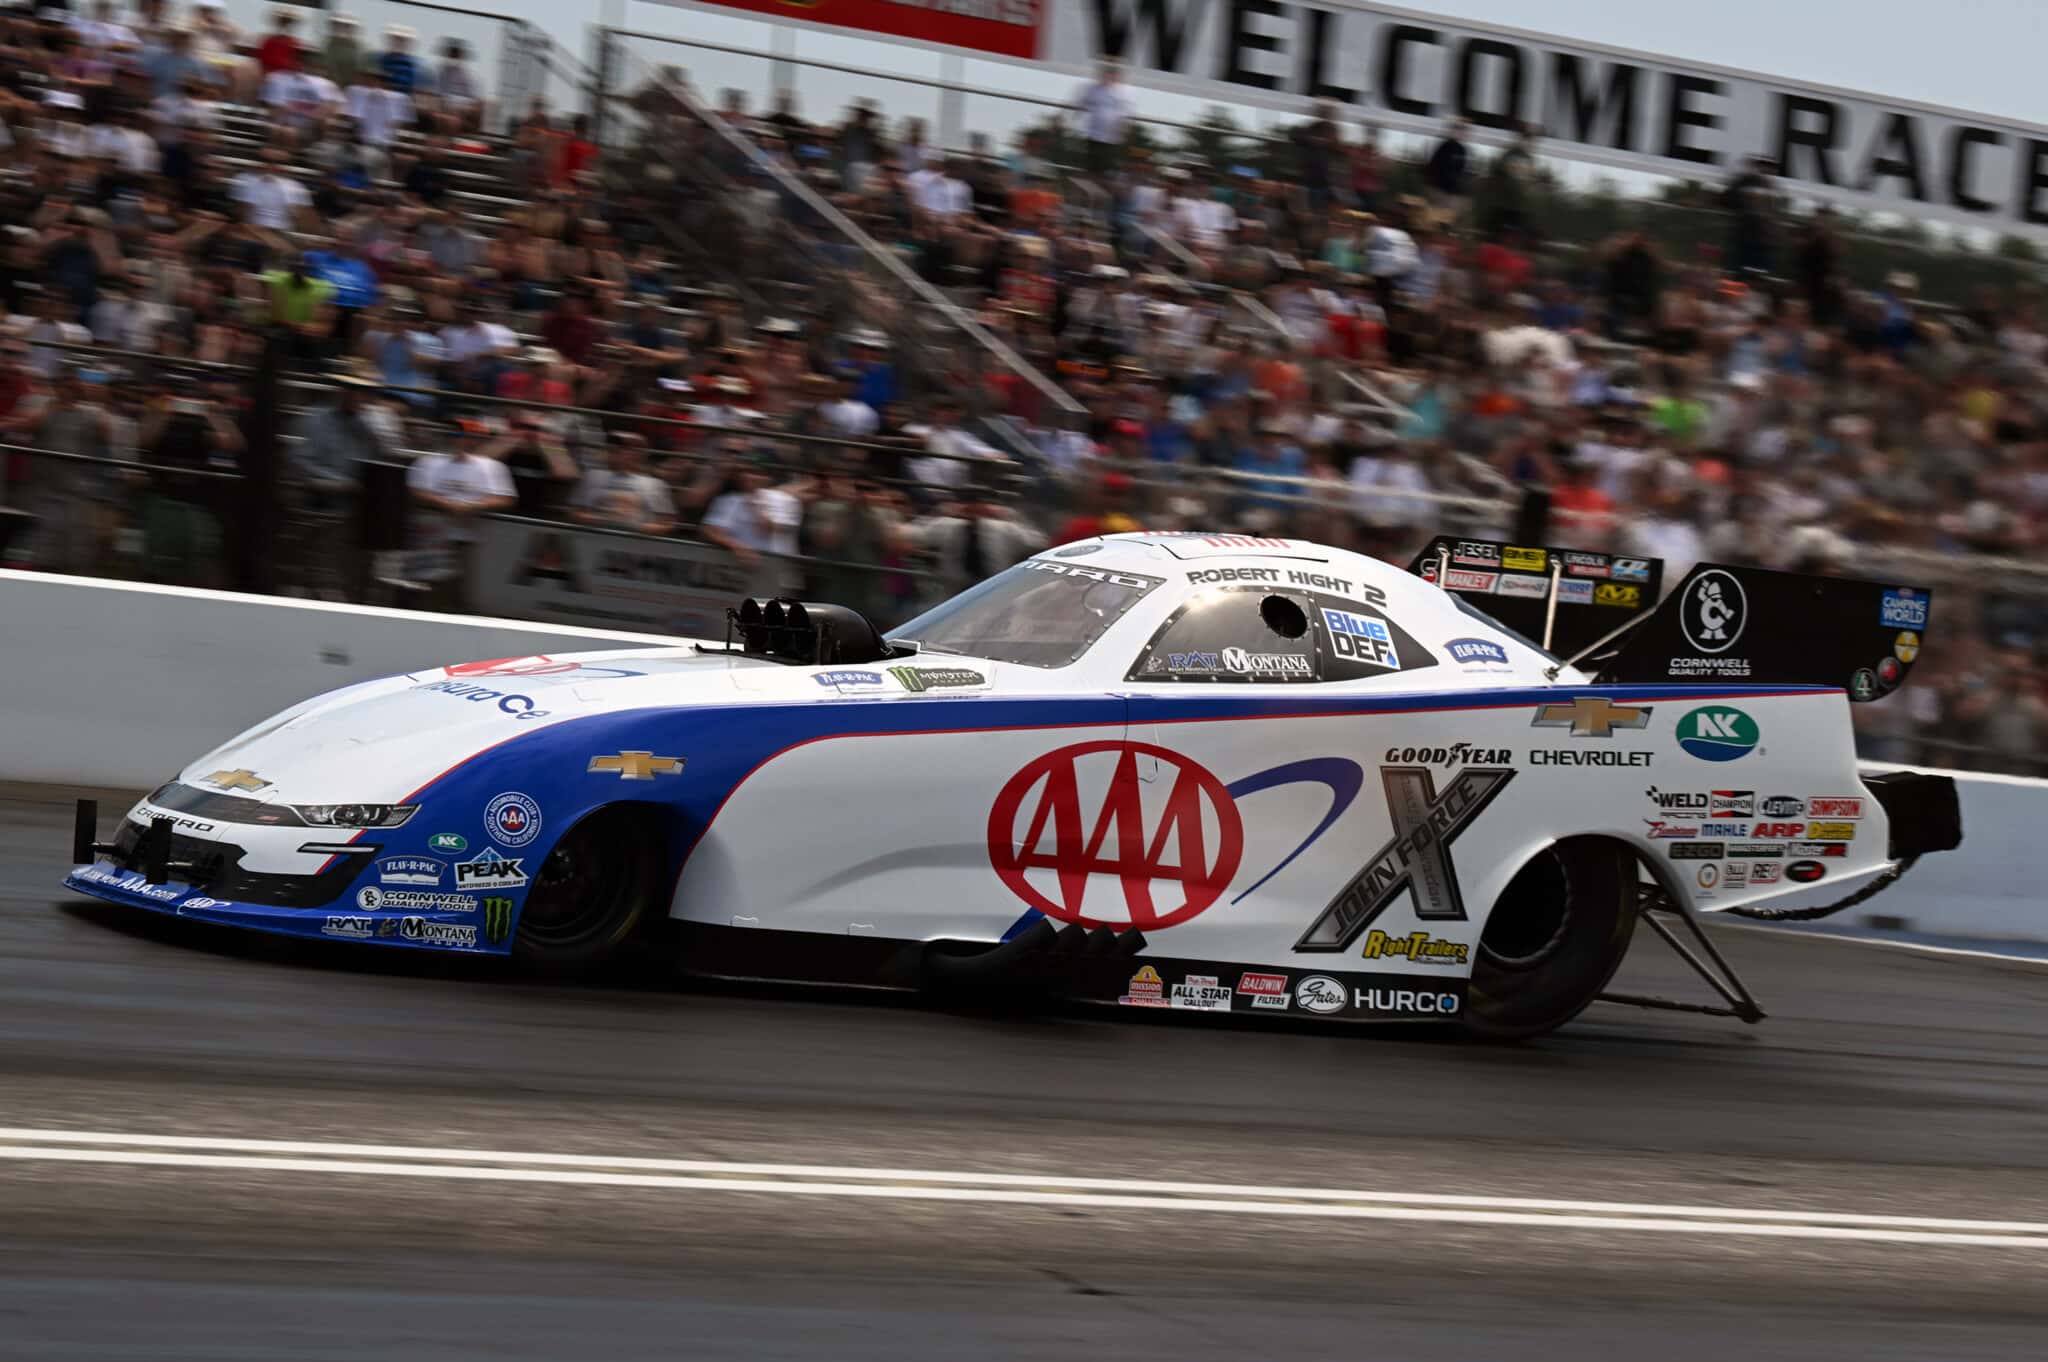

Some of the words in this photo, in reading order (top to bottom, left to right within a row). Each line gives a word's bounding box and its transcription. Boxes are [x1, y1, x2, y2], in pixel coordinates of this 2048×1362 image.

[1086, 0, 1726, 166] WELCOME
[1453, 542, 1500, 559] JESEL
[1186, 568, 1280, 584] ROBERT
[1288, 570, 1352, 594] HIGHT
[1363, 584, 1387, 608] 2
[1882, 596, 1927, 611] CAMPING
[1882, 607, 1925, 624] WORLD
[1324, 610, 1387, 641] Blue
[1331, 631, 1390, 662] DEF
[1222, 646, 1312, 674] MONTANA
[1670, 658, 1751, 668] CORNWELL
[919, 671, 978, 681] MONSTER
[1668, 668, 1714, 676] QUALITY
[1717, 668, 1752, 676] TOOLS
[1697, 713, 1741, 737] NK
[1530, 750, 1655, 767] CHEVROLET
[1659, 793, 1708, 808] WELD
[1711, 799, 1754, 809] CHAMPION
[1809, 799, 1860, 816] SIMPSON
[501, 811, 526, 825] AAA
[988, 740, 1244, 932] AAA
[1701, 824, 1748, 837] MAHLE
[1752, 823, 1805, 838] ARP
[437, 835, 458, 847] NK
[1333, 857, 1398, 938] JOHN
[1395, 776, 1478, 867] FORCE
[457, 860, 523, 883] PEAK
[383, 890, 475, 904] CORNWELL
[382, 900, 434, 910] QUALITY
[437, 902, 476, 912] TOOLS
[403, 917, 475, 940] MONTANA
[1242, 974, 1282, 993] BALDWIN
[1257, 995, 1286, 1006] FILTERS
[1300, 981, 1345, 1005] Gates
[1355, 988, 1459, 1014] HURCO
[1183, 998, 1217, 1008] CALLOUT
